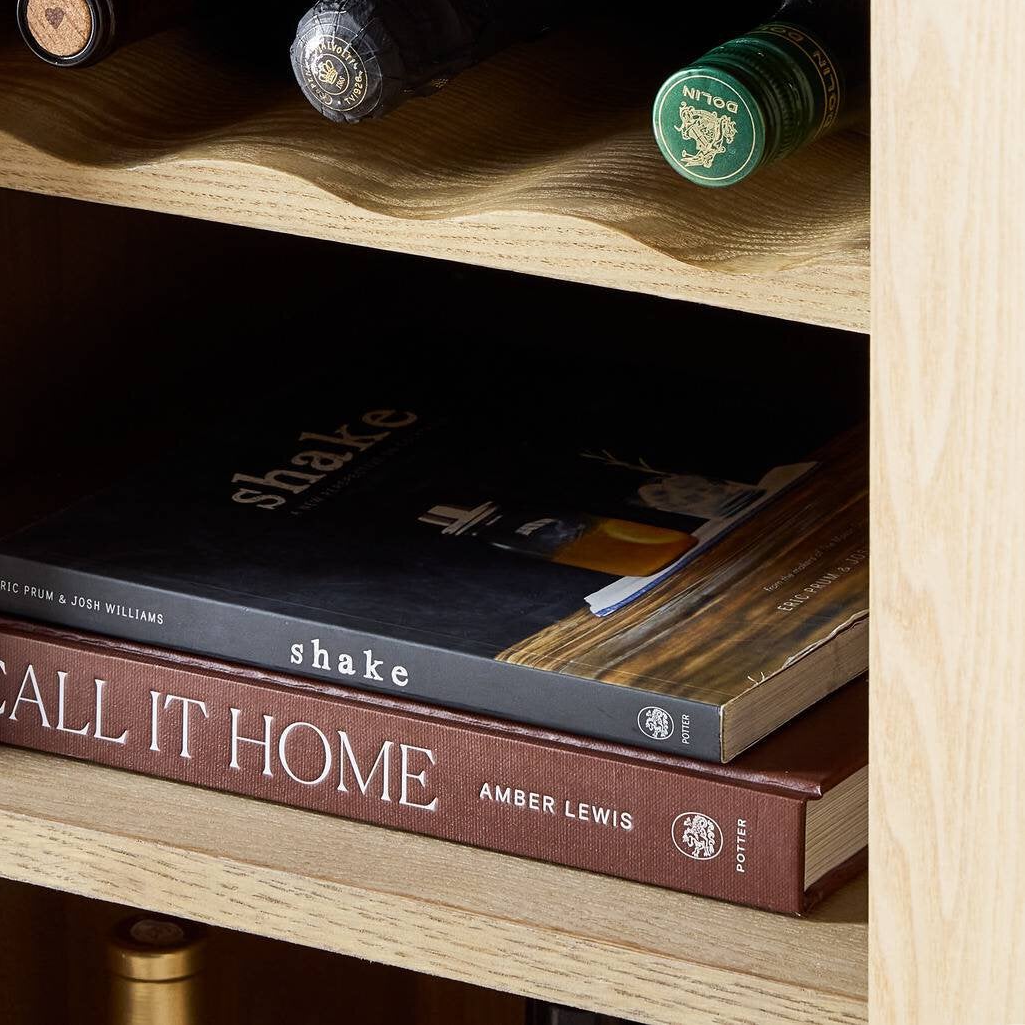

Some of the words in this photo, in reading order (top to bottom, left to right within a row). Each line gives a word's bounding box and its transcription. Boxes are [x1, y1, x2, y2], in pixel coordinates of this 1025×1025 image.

[681, 84, 739, 115] DOLIN
[230, 407, 419, 511] shake
[23, 585, 54, 602] PRUM
[58, 593, 68, 605] &
[71, 595, 101, 612] JOSH
[105, 603, 164, 625] WILLIAMS
[777, 593, 810, 612] ERIC
[290, 638, 410, 688] shake
[681, 713, 691, 745] POTTER
[149, 690, 209, 759] IT
[228, 706, 439, 812] HOME
[479, 782, 556, 813] AMBER
[565, 799, 634, 831] LEWIS
[736, 818, 748, 873] POTTER
